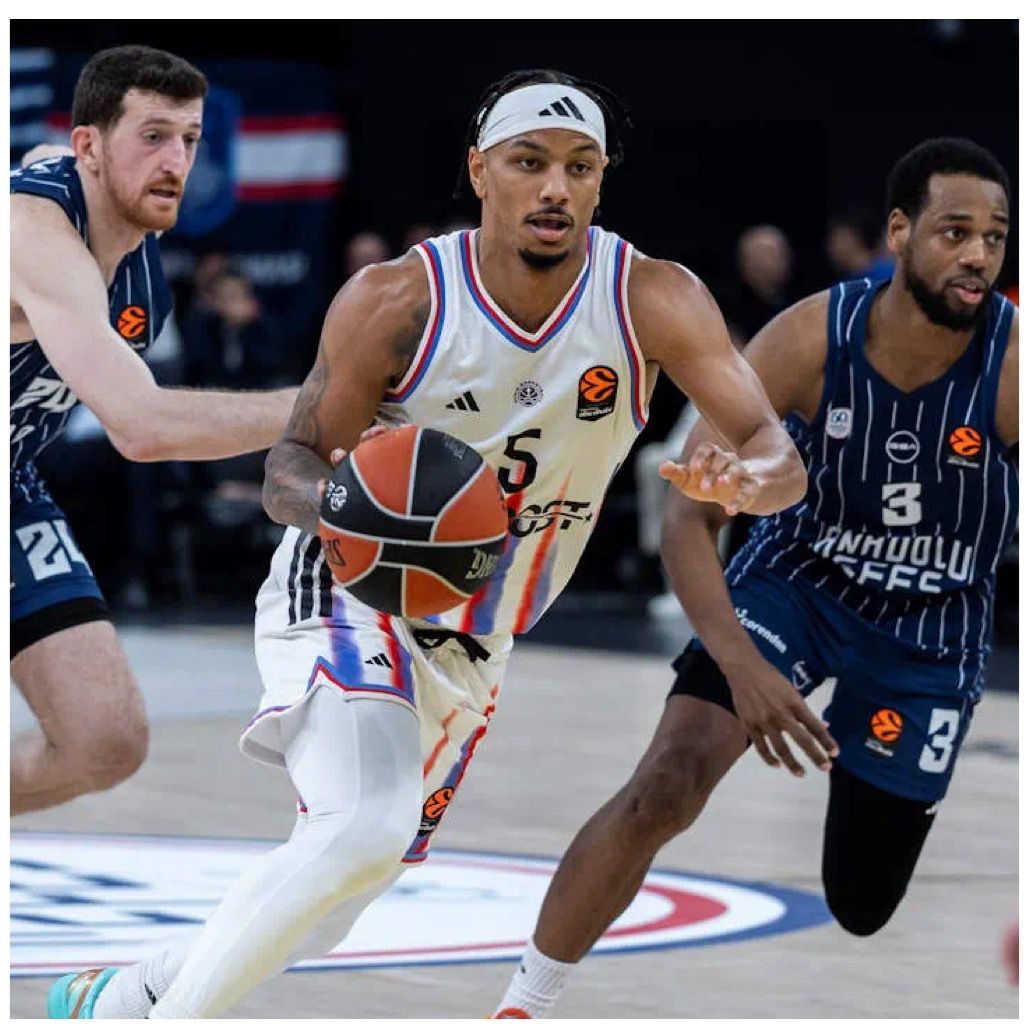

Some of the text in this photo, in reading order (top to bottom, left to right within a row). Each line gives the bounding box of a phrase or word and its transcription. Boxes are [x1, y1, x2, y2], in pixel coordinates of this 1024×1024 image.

[498, 429, 541, 493] 5
[881, 482, 922, 527] 3
[813, 526, 974, 581] ANADOLU
[918, 708, 960, 773] 3
